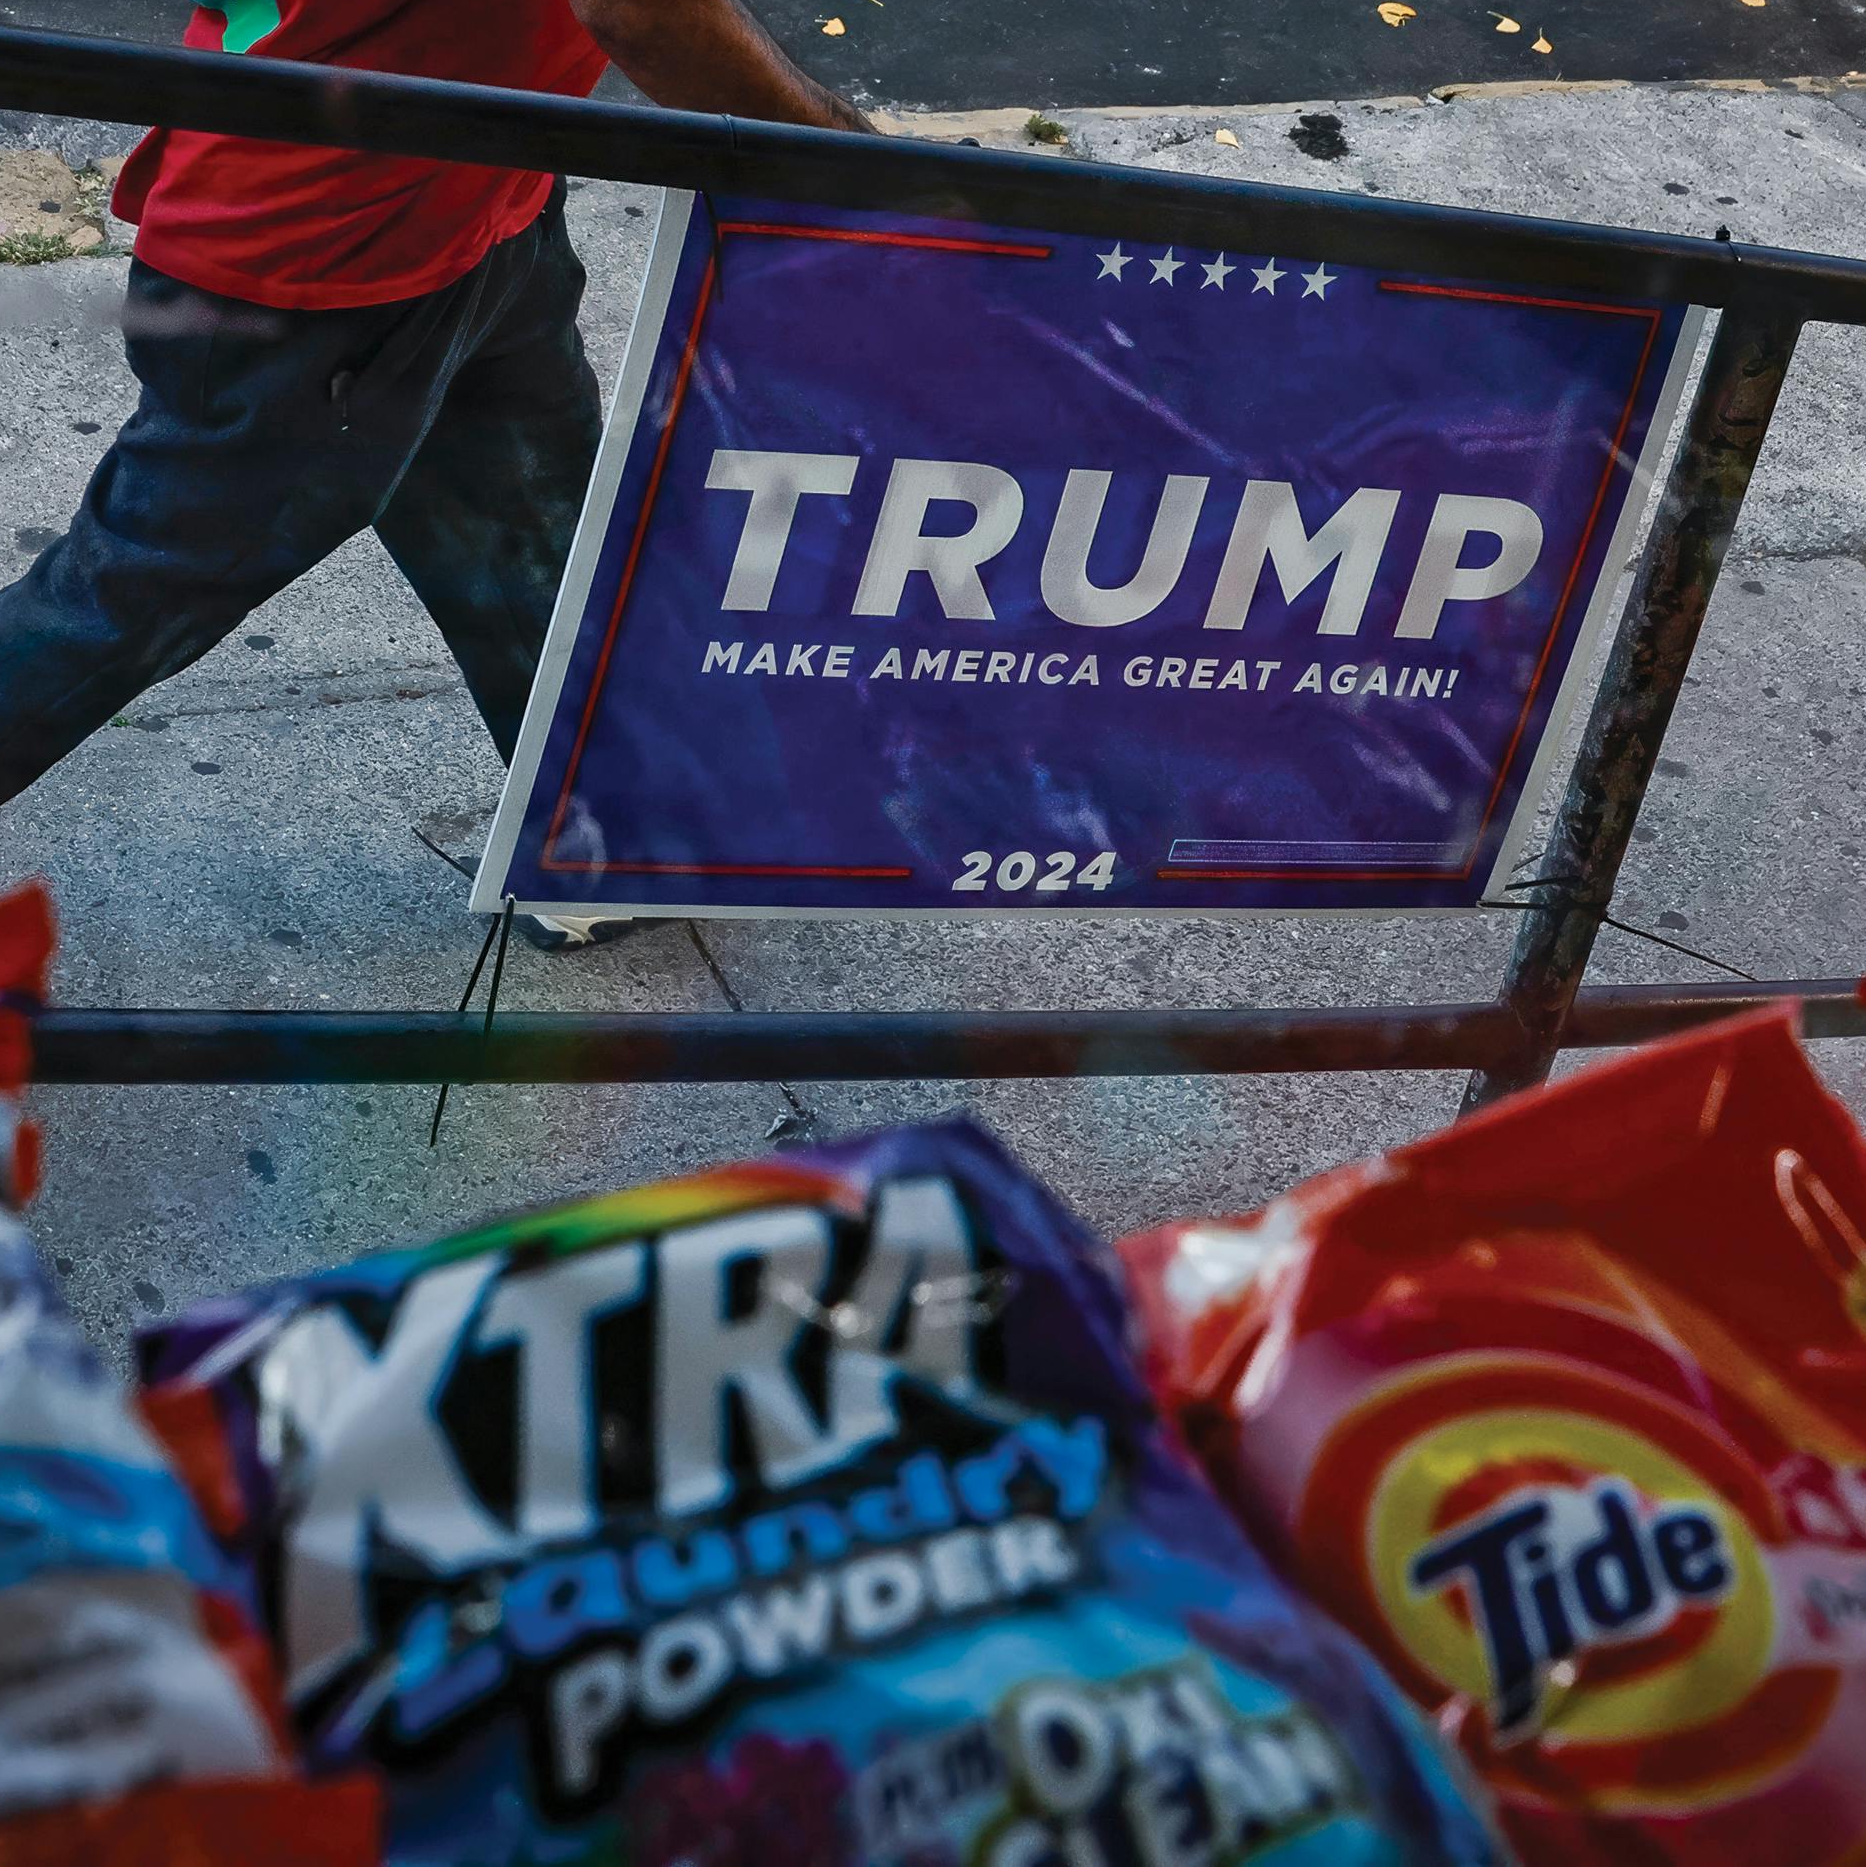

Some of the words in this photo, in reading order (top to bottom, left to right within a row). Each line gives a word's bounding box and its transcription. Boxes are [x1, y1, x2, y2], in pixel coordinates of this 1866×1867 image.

[703, 448, 1543, 640] TRUMP
[701, 641, 855, 679] MAKE
[869, 646, 1102, 687] AMERICA
[1123, 655, 1280, 694] GREAT
[1292, 661, 1460, 700] AGAIN!
[951, 850, 1117, 892] 2024
[258, 1174, 993, 1714] XTRA
[548, 1521, 1077, 1796] POWDER
[1410, 1479, 1739, 1741] Tide
